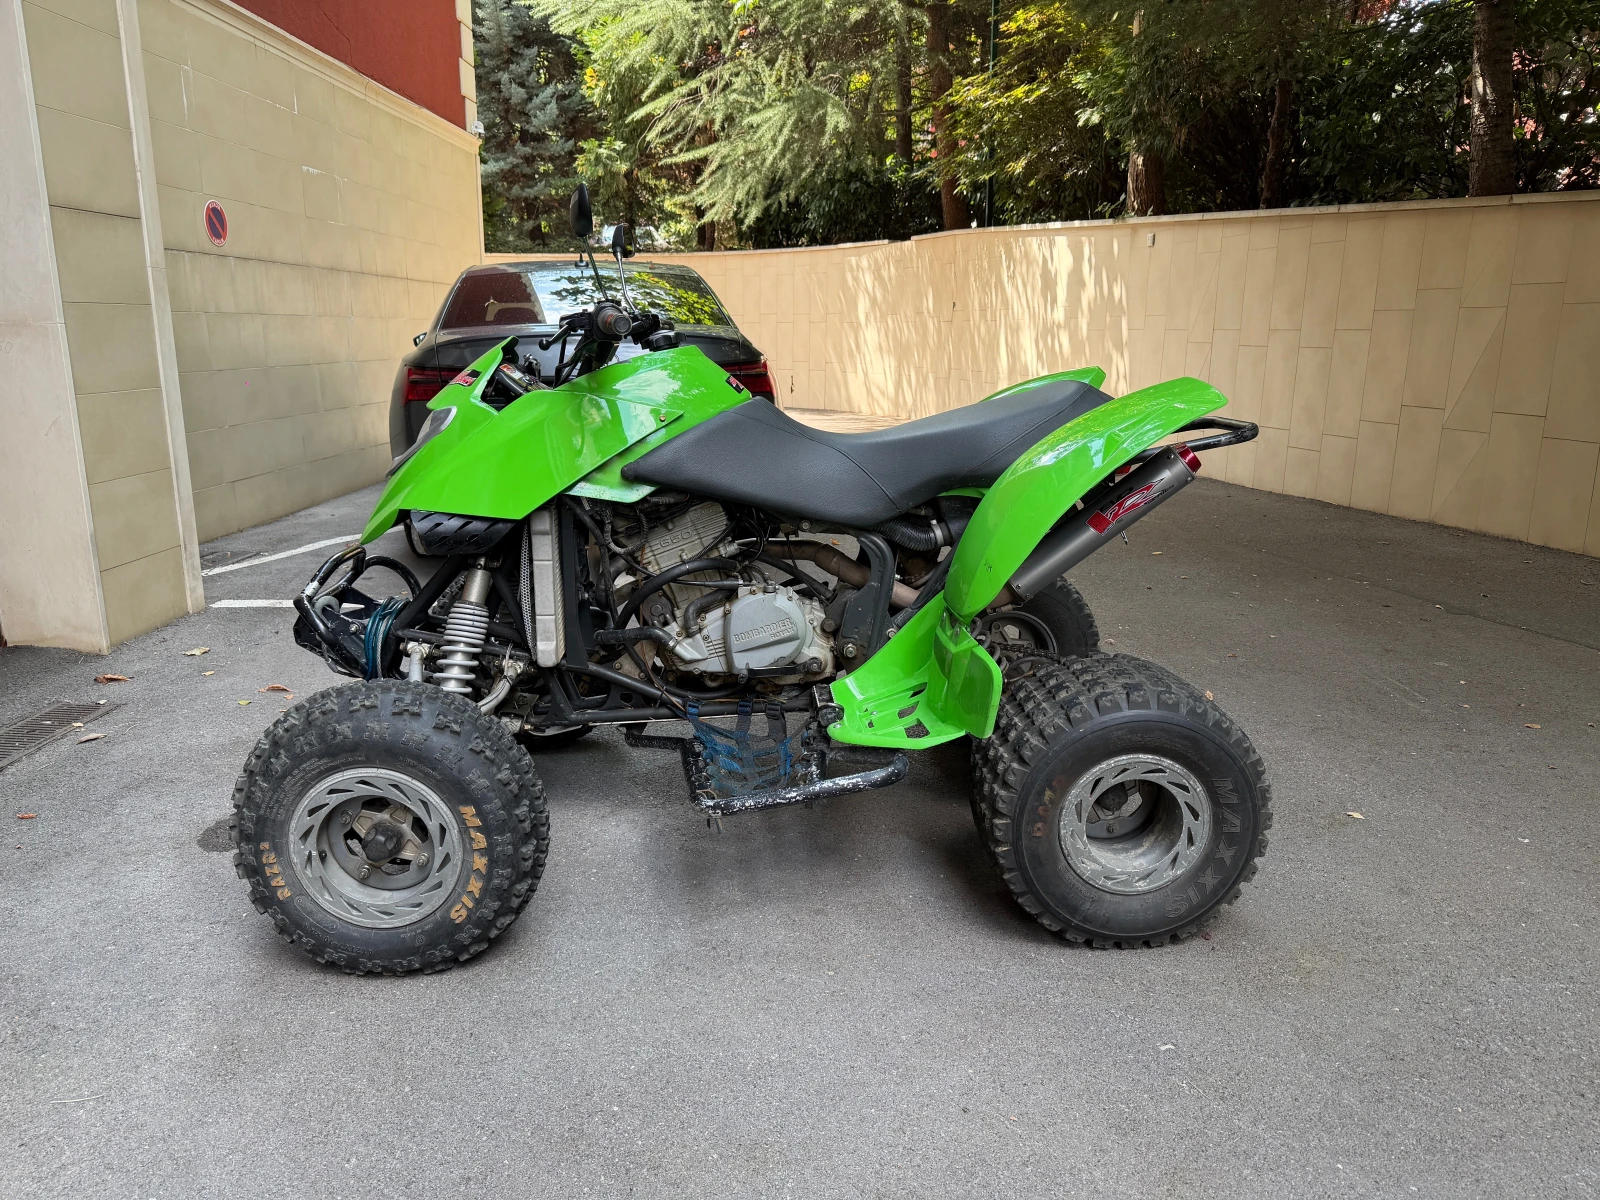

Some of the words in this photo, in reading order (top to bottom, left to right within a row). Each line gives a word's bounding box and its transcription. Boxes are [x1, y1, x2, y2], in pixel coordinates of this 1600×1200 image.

[732, 617, 793, 644] BOMBARDIER
[449, 804, 489, 925] MAXXIS
[1163, 777, 1242, 919] MAXXIS
